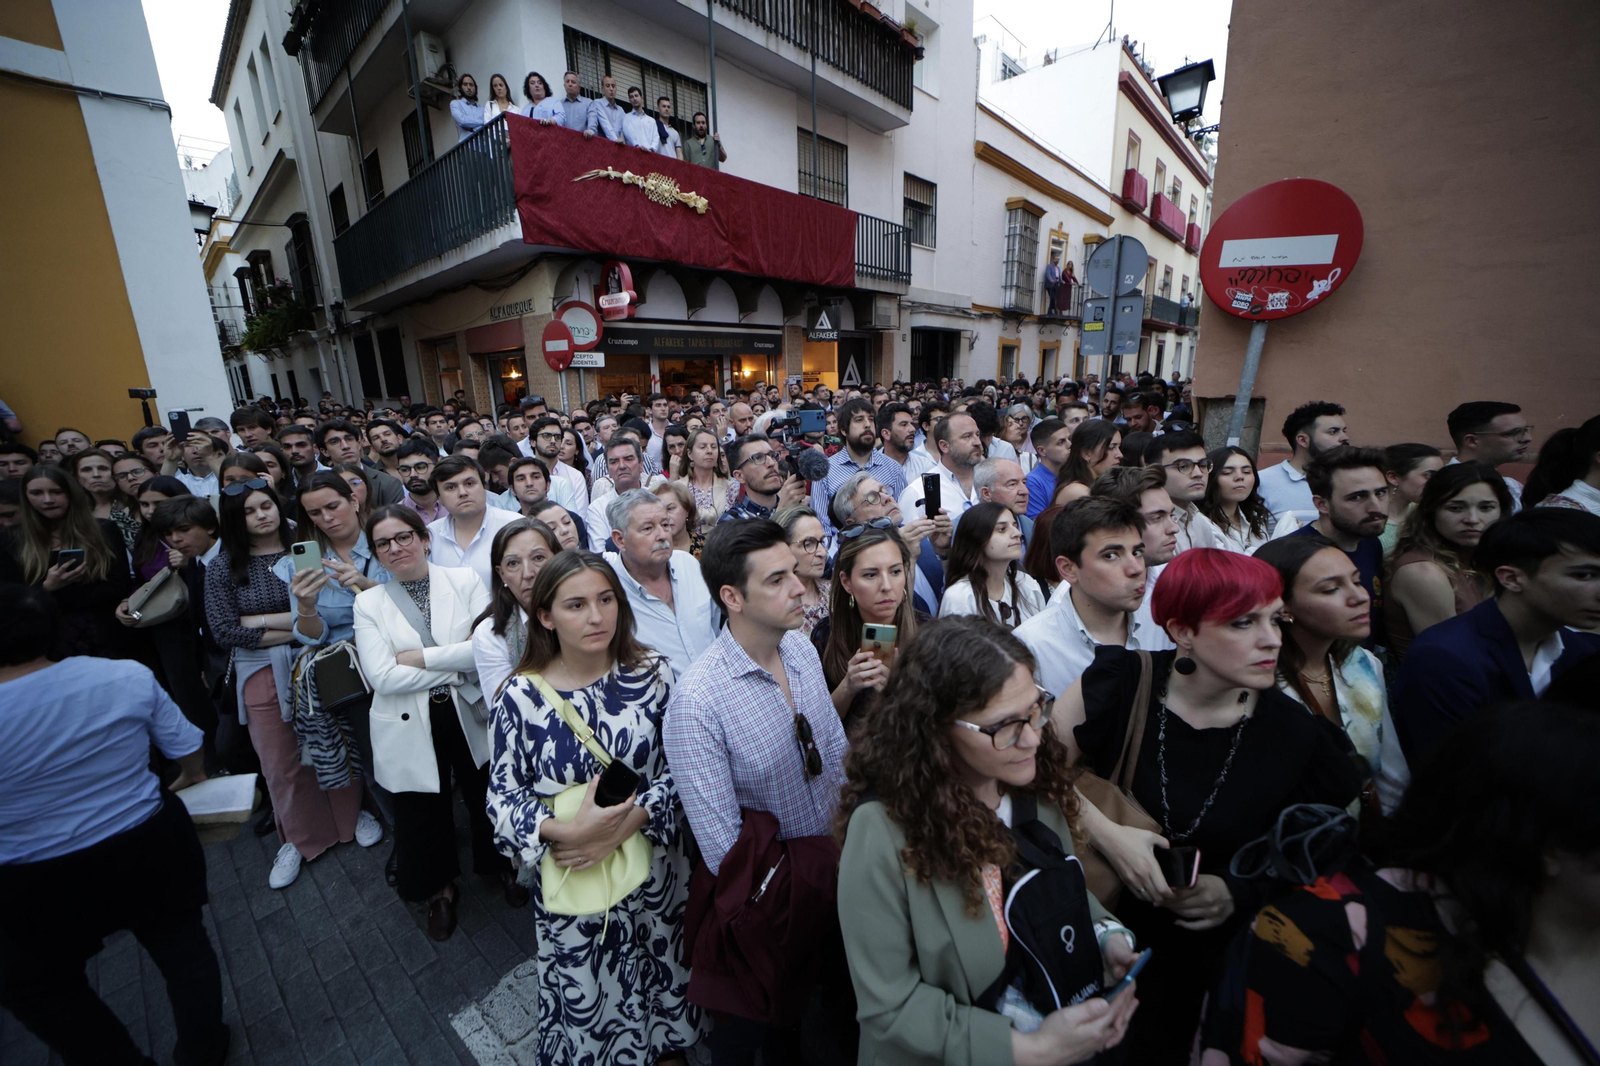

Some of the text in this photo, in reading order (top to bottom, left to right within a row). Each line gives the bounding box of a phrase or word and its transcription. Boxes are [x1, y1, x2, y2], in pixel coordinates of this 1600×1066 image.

[490, 298, 533, 319] ALFAQUEQUE
[607, 337, 639, 346] Cruzcampo
[653, 337, 743, 348] ALFAKEKE TAPAS & BREAKFAST
[753, 341, 775, 349] Cruzcampo
